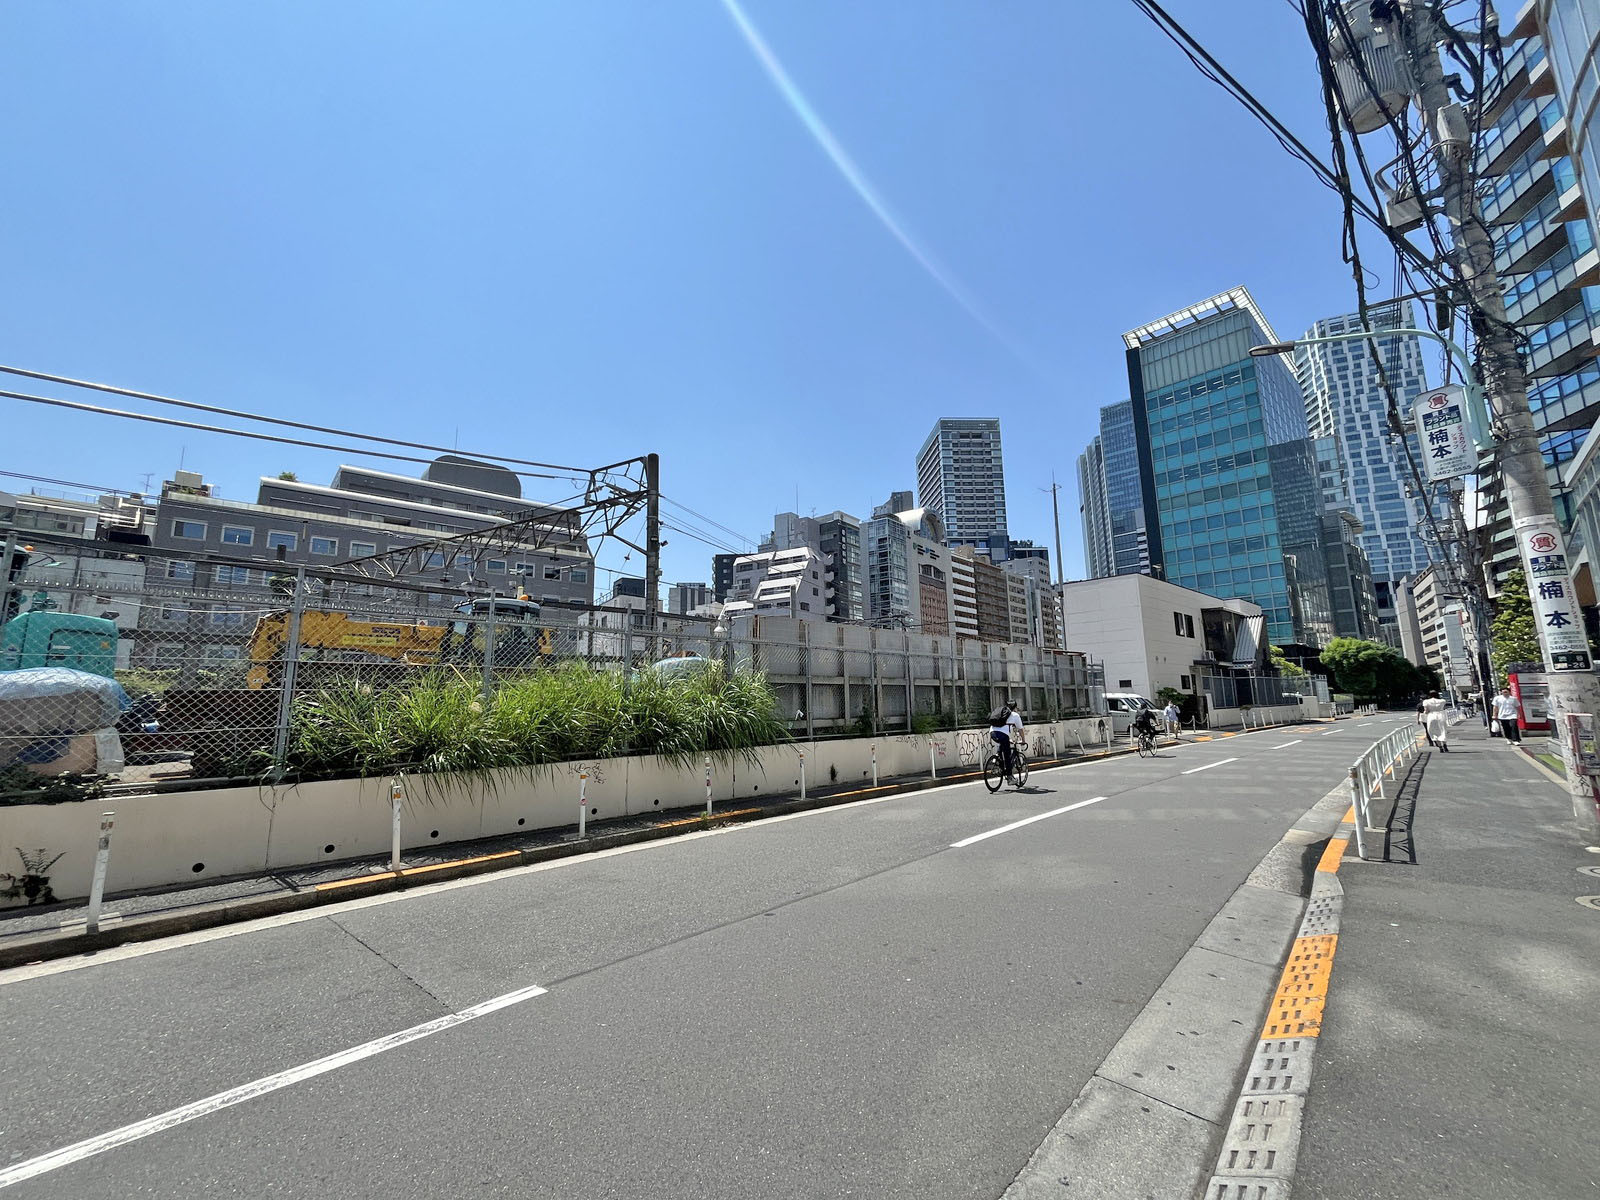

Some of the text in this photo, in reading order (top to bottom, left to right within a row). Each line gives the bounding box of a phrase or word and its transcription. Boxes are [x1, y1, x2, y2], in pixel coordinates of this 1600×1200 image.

[1428, 428, 1452, 459] 楠本
[1433, 465, 1472, 476] 3462-0555
[1538, 580, 1571, 629] 楠本
